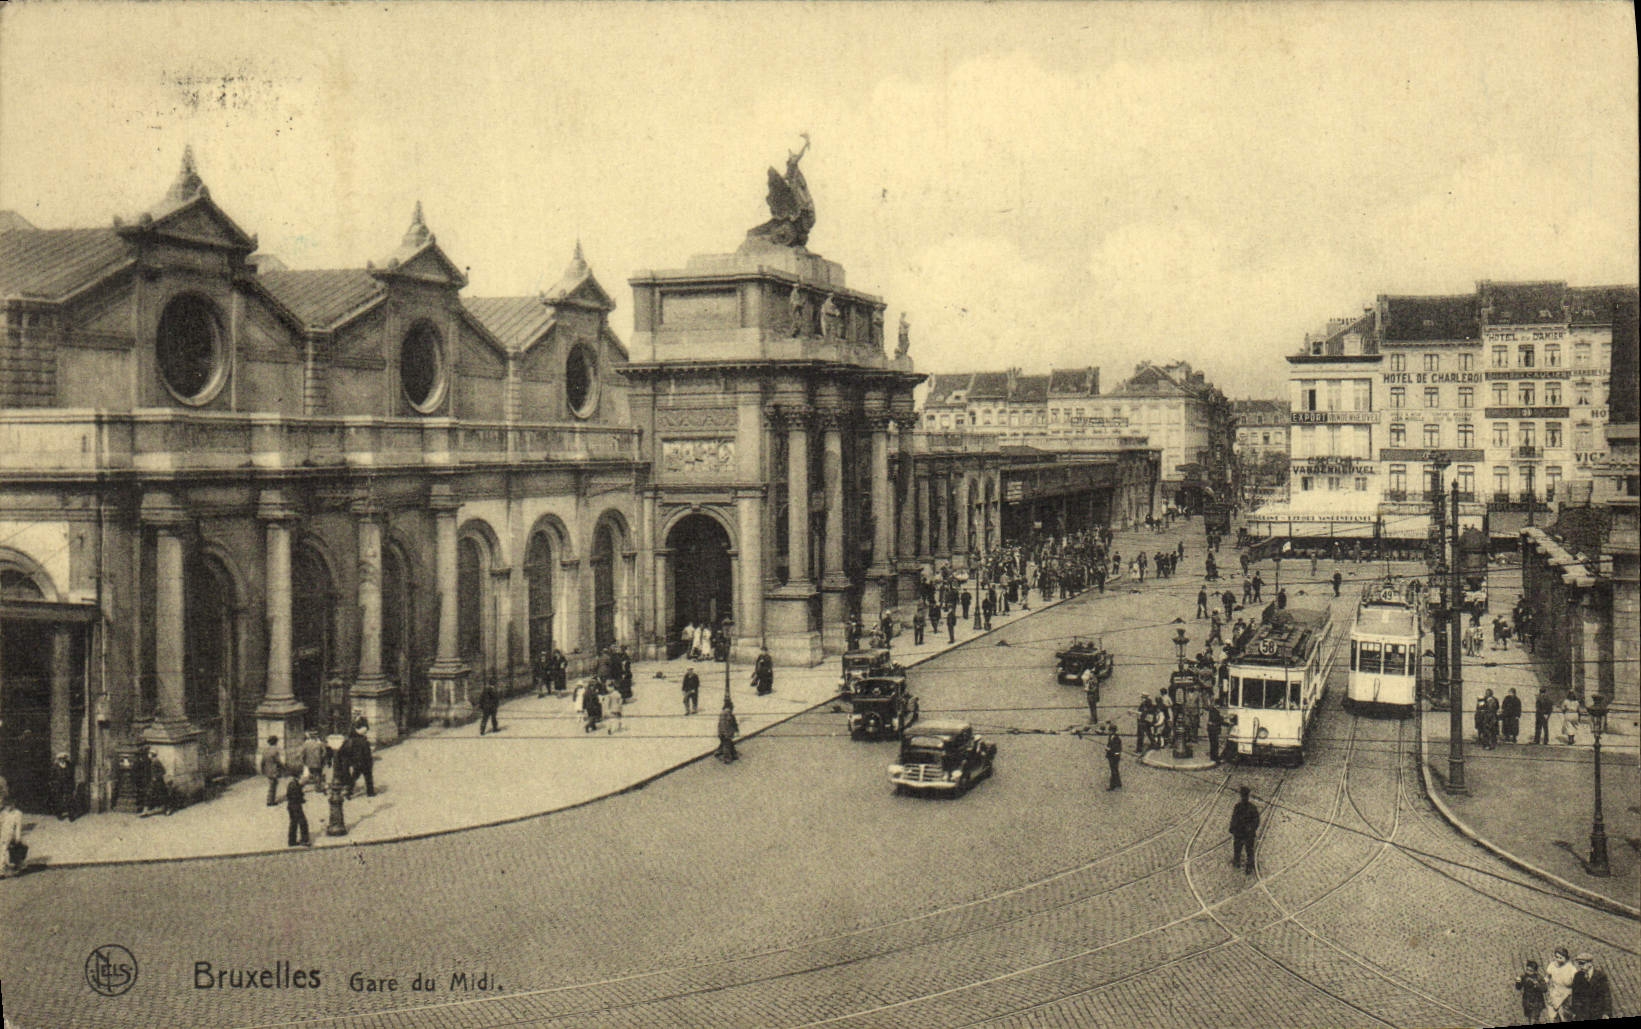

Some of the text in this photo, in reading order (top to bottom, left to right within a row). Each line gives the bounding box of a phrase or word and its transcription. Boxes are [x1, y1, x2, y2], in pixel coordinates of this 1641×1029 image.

[1383, 373, 1413, 383] HOTEL
[1416, 373, 1428, 383] DE
[1431, 373, 1483, 383] CHARLEROI
[1292, 412, 1327, 422] EXPORT
[1591, 410, 1608, 418] HO
[1382, 590, 1394, 601] 49
[1262, 641, 1275, 655] 58
